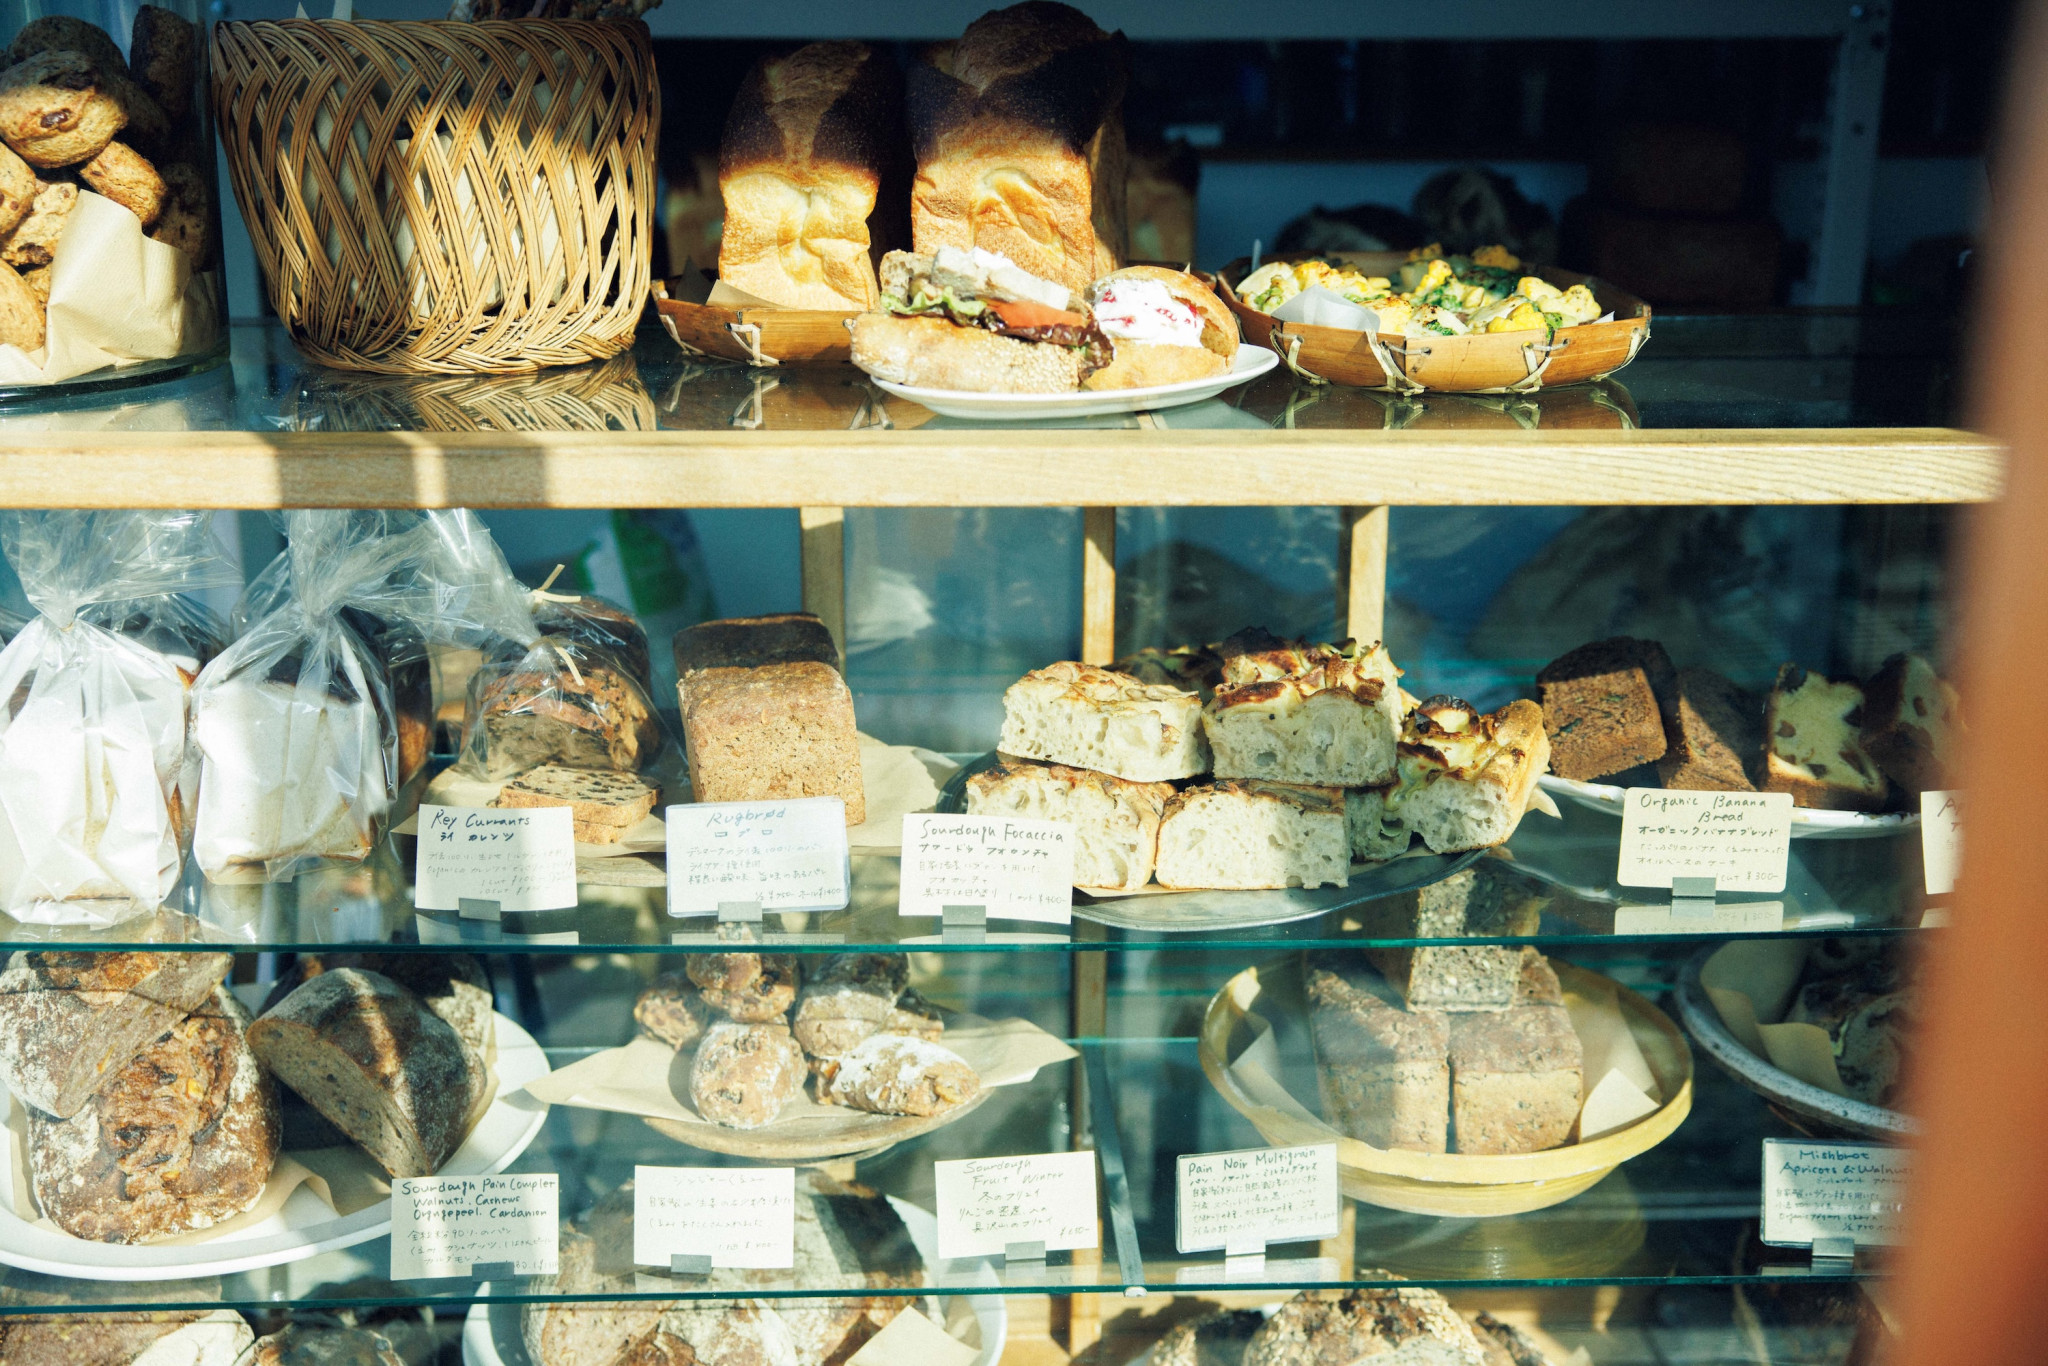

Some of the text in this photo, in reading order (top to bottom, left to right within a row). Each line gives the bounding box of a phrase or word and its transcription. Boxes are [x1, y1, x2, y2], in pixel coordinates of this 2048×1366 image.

[1640, 794, 1766, 812] Organic Banana
[1698, 812, 1744, 823] Bread
[920, 819, 1064, 844] Sourdough Focaccia
[1188, 1148, 1316, 1177] Pain Noir Multigrain
[1780, 1162, 1837, 1176] Apricots
[482, 1178, 506, 1193] Pain
[972, 1174, 1010, 1190] Fruit
